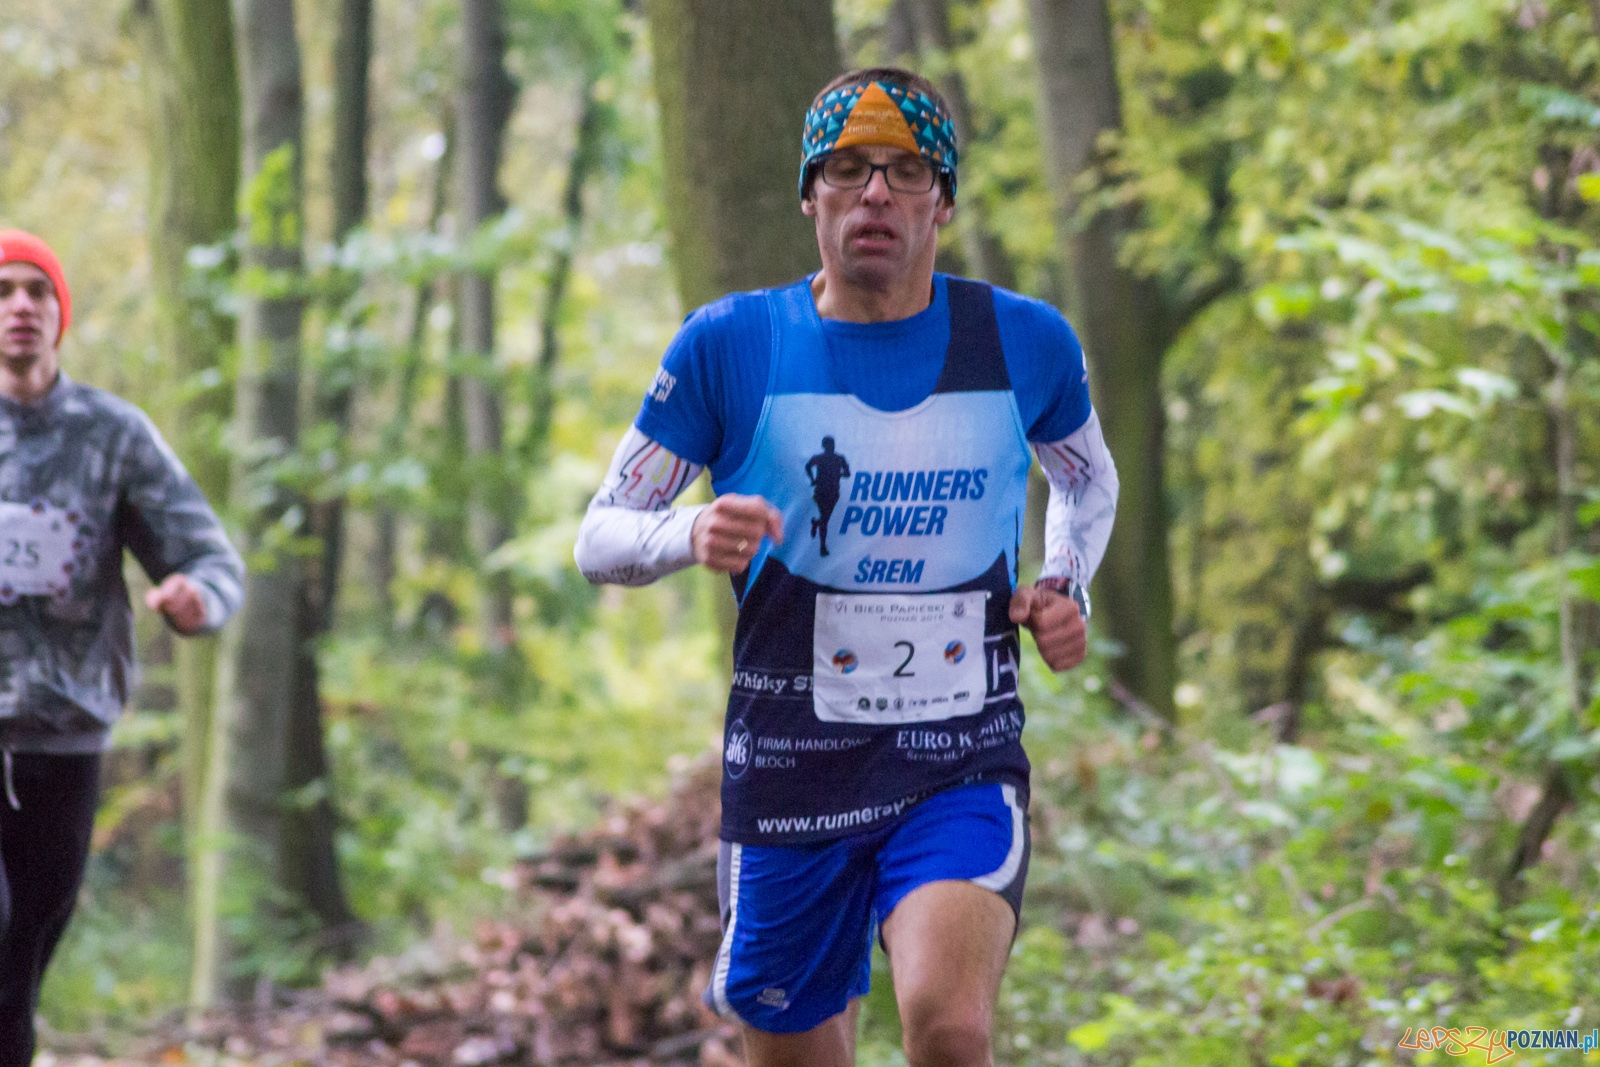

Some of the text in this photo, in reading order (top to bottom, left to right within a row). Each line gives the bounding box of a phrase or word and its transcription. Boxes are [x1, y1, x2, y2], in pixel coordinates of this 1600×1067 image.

[851, 468, 988, 501] RUNNER'S
[839, 505, 948, 536] POWER
[4, 540, 40, 569] 25
[854, 554, 925, 584] ŚREM
[892, 640, 916, 677] 2
[732, 671, 787, 694] Whisky
[757, 736, 792, 750] FIRMA
[896, 729, 952, 750] EURO
